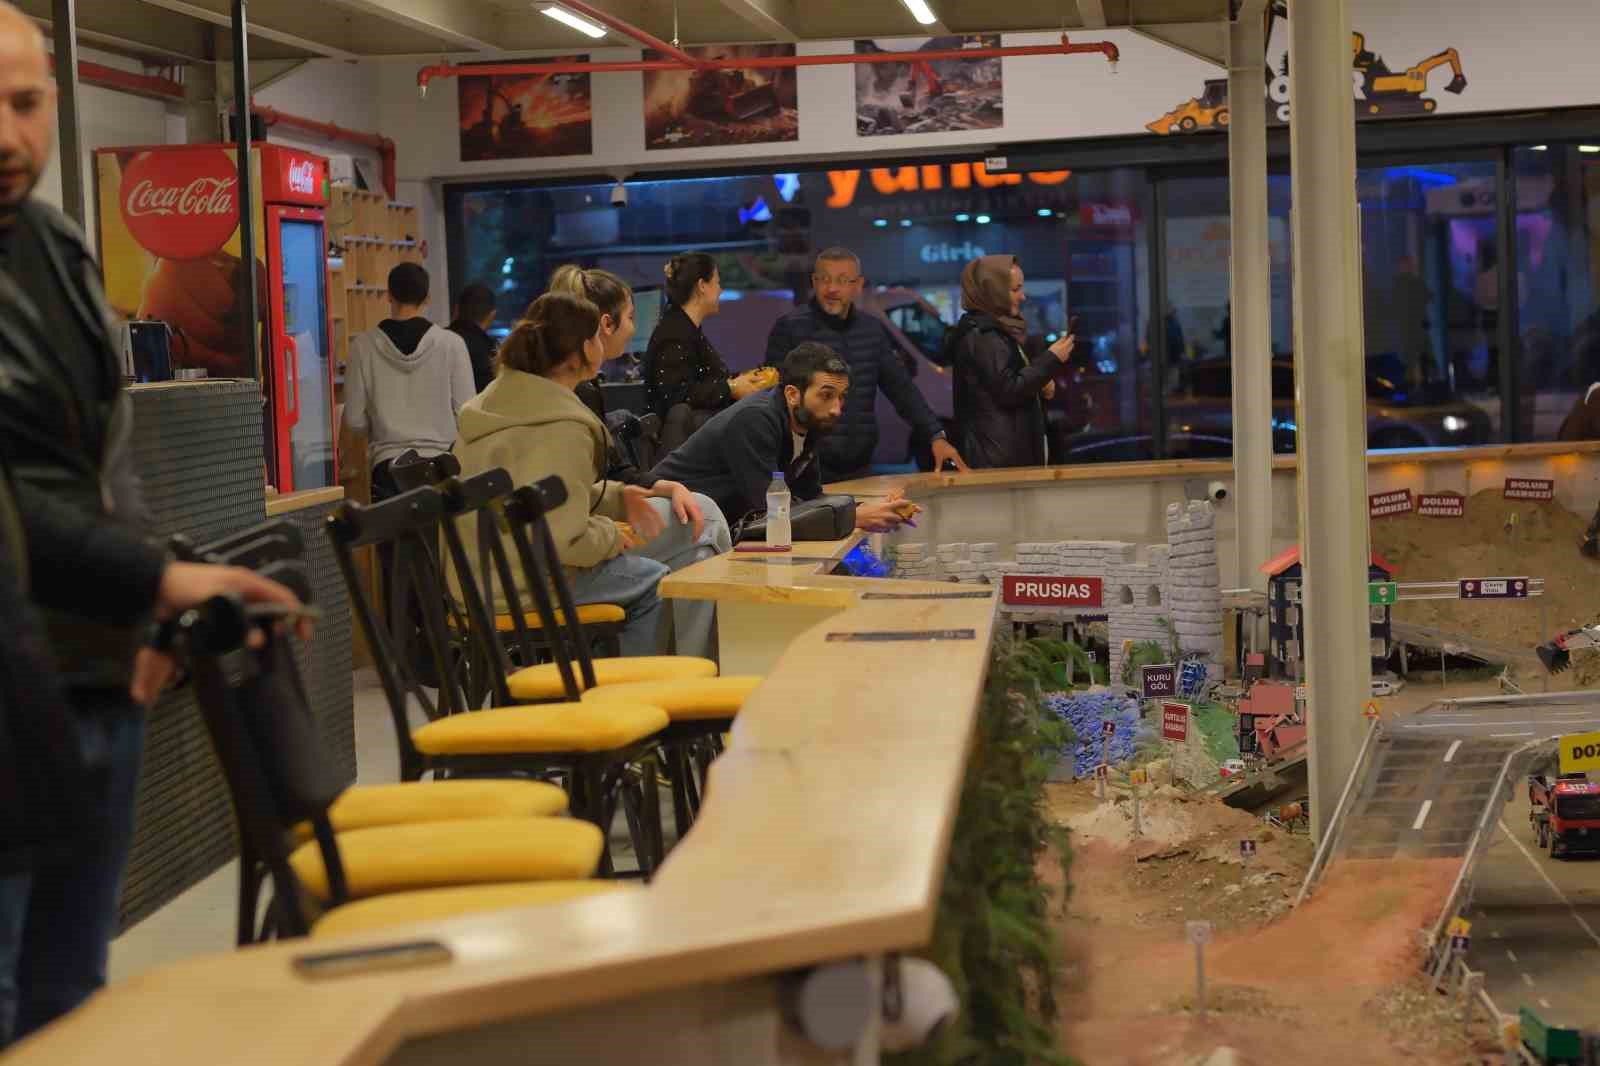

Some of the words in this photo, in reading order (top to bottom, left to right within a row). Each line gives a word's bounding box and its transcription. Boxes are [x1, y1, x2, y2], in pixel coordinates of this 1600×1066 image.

[127, 176, 238, 217] Coca-Cola
[1373, 492, 1407, 505] DOLUM
[1422, 497, 1460, 506] DOLUM
[1015, 582, 1091, 599] PRUSIAS
[1147, 673, 1171, 682] KURU
[1150, 682, 1169, 690] GÖL
